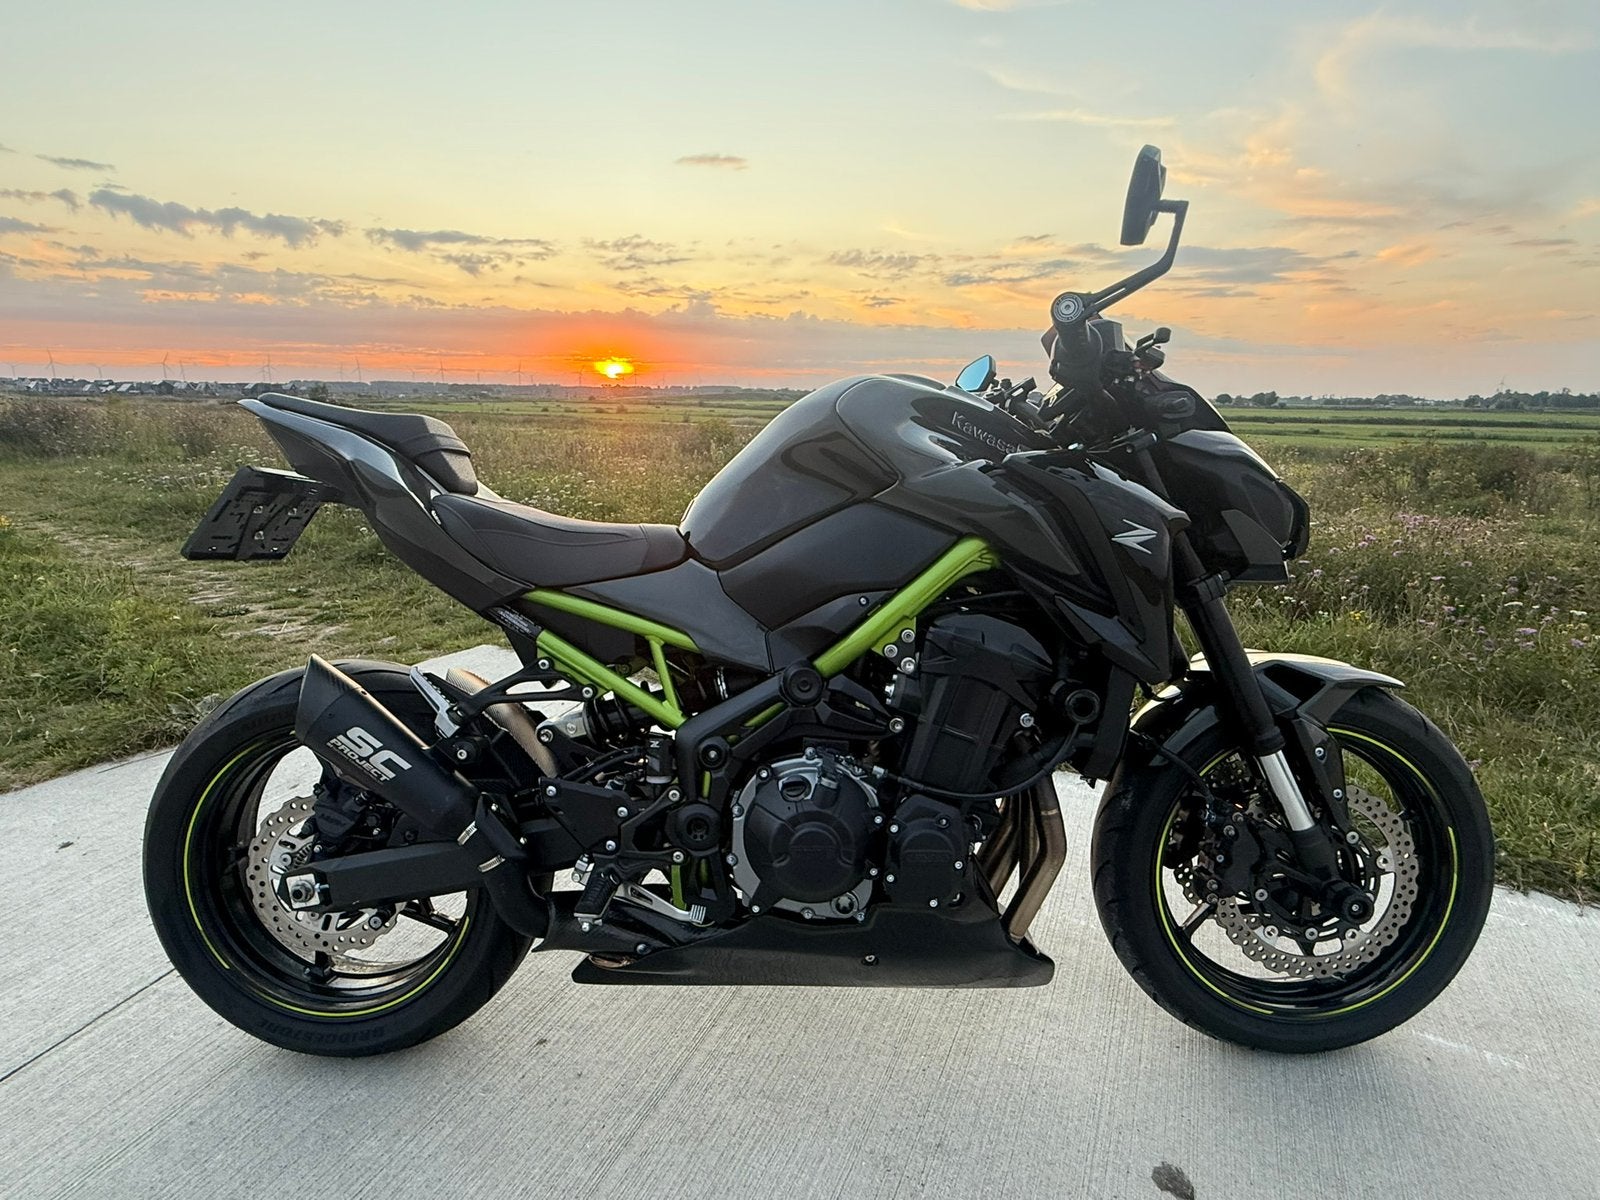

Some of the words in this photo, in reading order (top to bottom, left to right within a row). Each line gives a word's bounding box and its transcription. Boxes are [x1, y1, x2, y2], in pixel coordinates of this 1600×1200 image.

[951, 411, 1022, 453] Kawasak
[326, 737, 390, 781] PROJECT
[336, 726, 412, 779] SC
